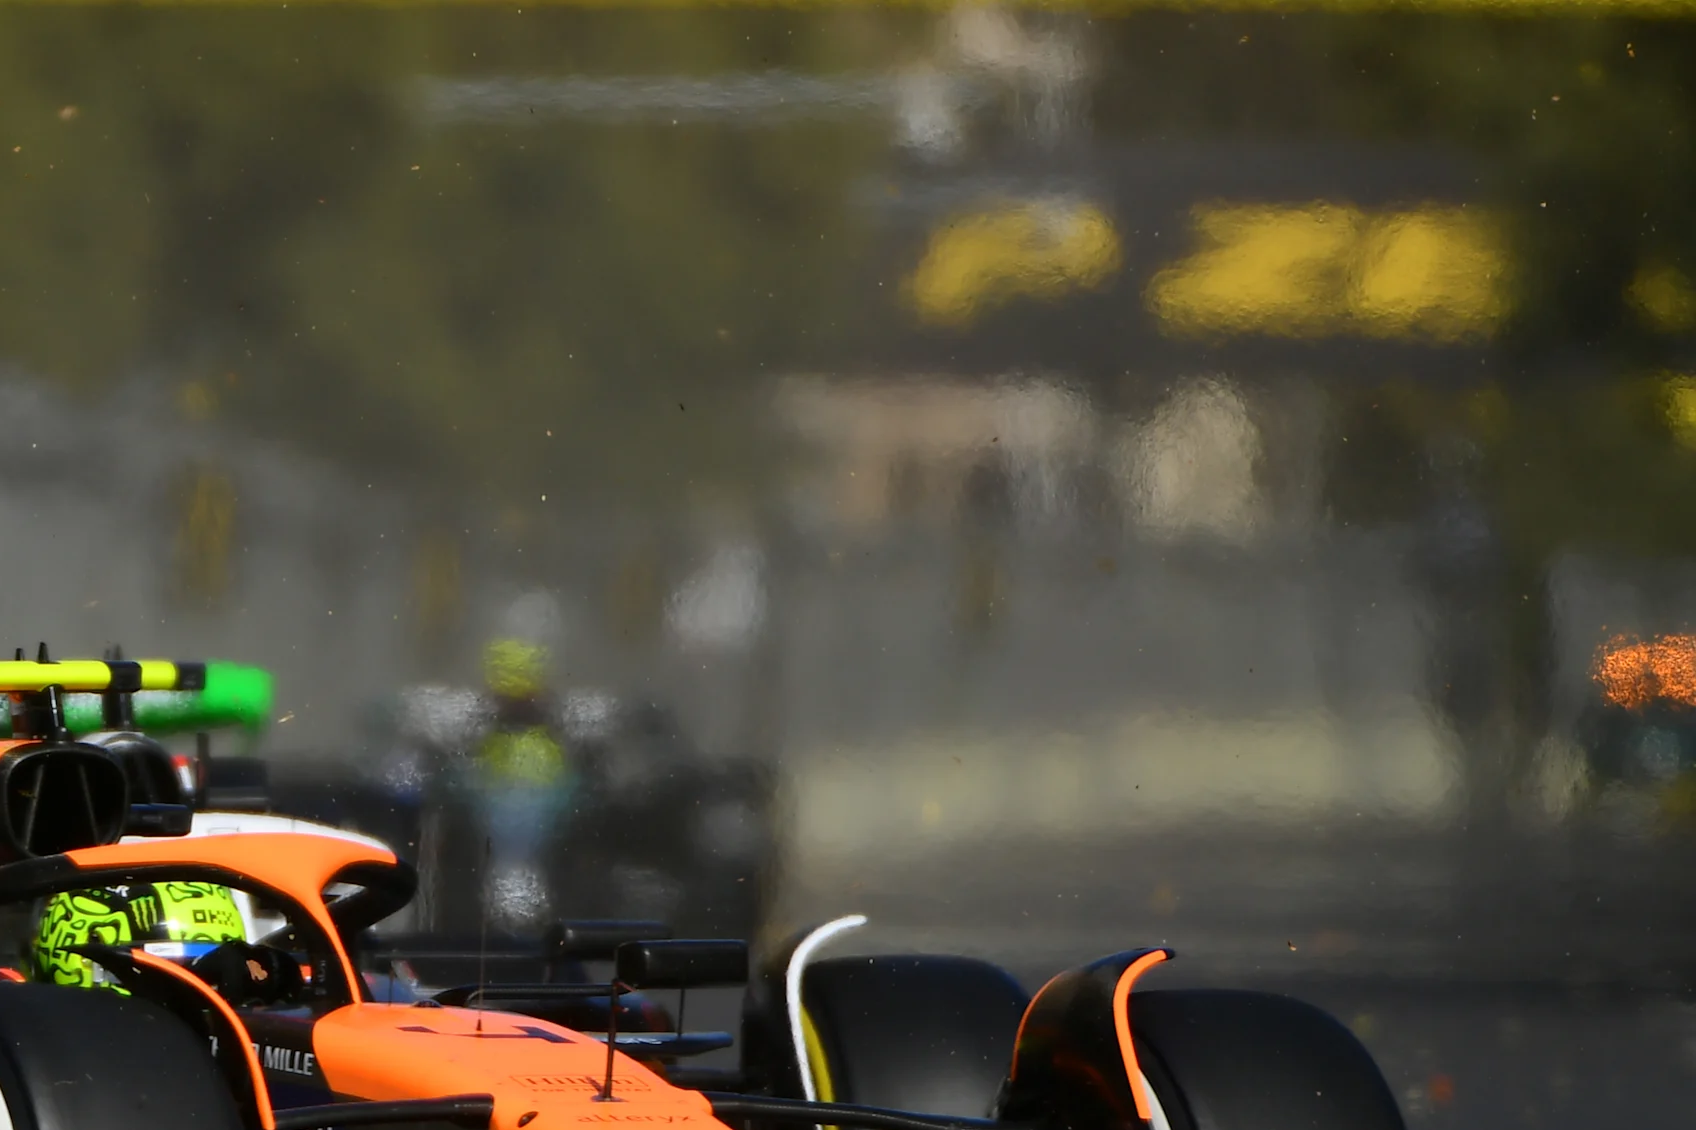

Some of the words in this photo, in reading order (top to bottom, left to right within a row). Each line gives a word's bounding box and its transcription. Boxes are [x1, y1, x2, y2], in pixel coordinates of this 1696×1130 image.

[264, 1045, 316, 1076] MILLE
[525, 1074, 634, 1086] Hiltn
[577, 1113, 697, 1124] alteryx
